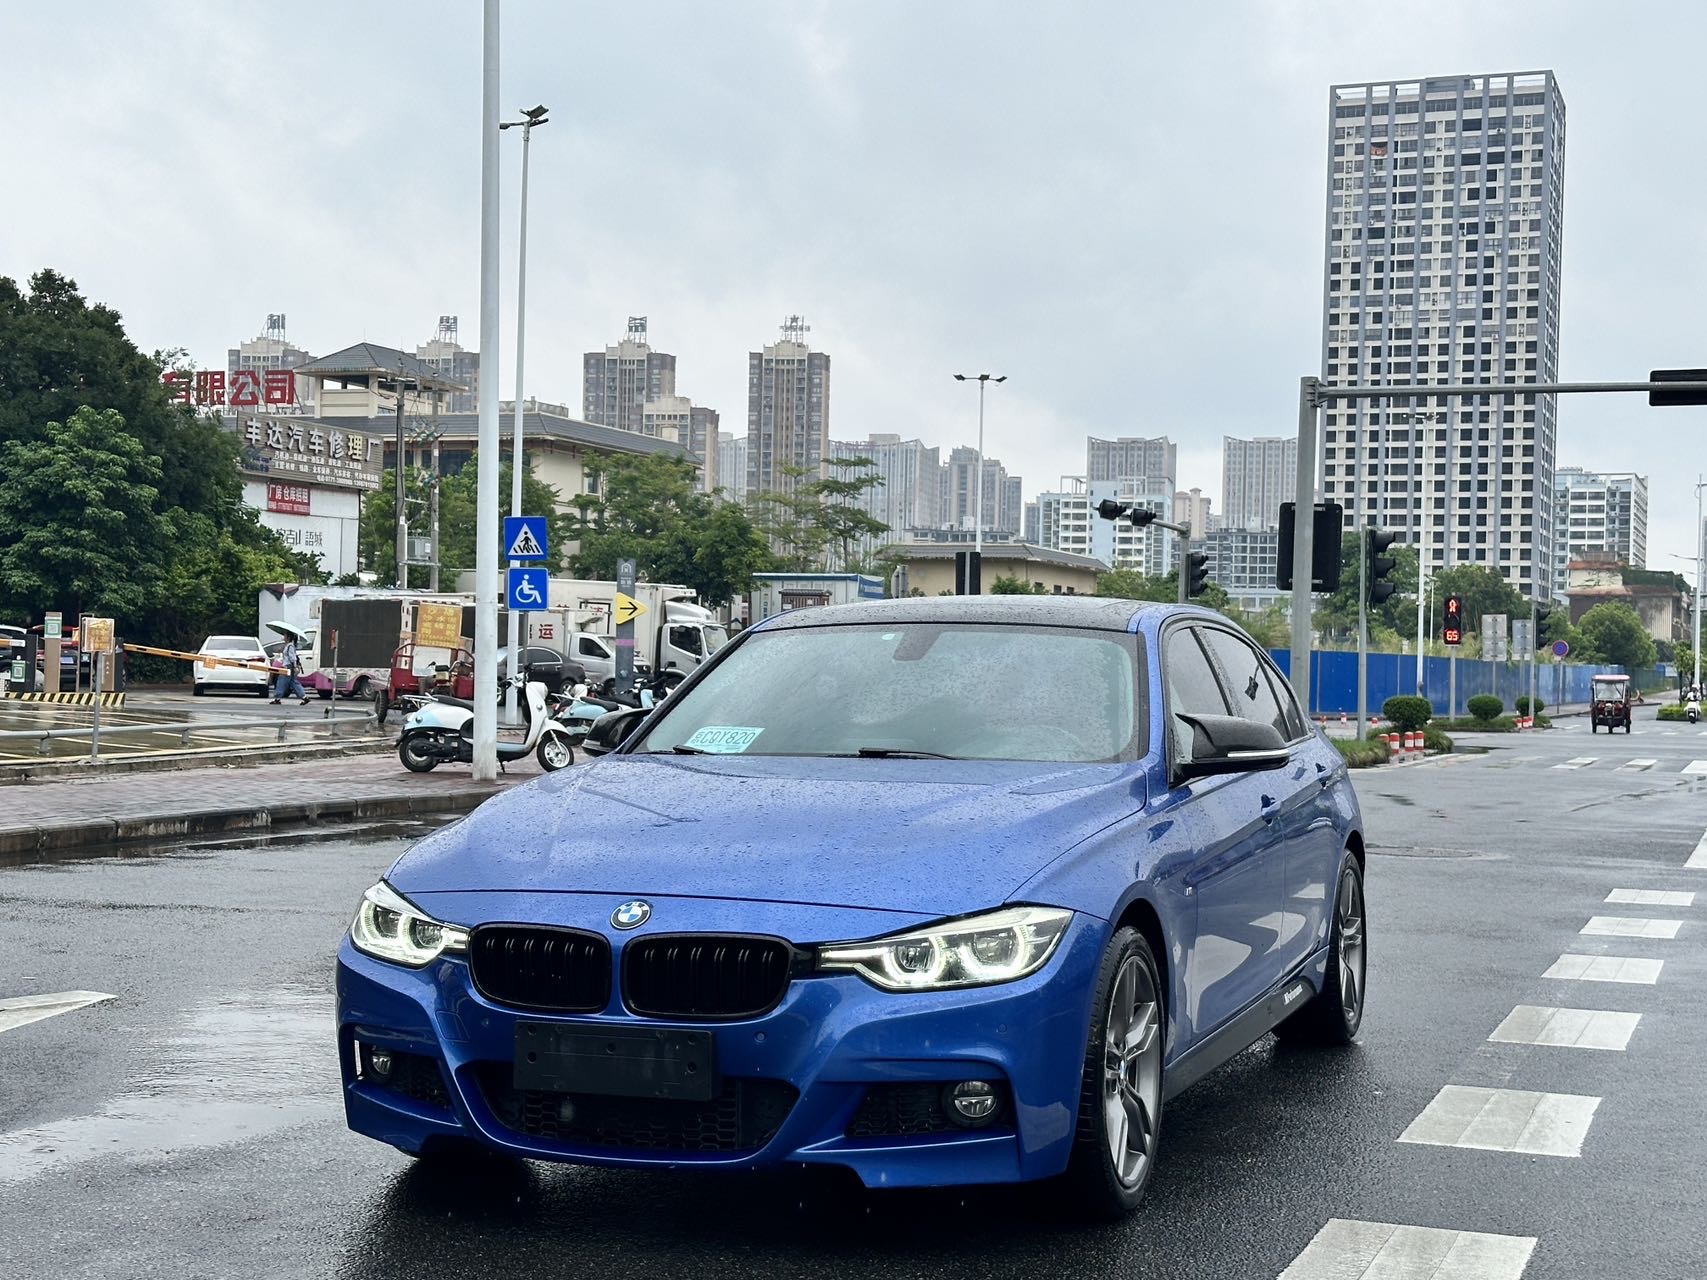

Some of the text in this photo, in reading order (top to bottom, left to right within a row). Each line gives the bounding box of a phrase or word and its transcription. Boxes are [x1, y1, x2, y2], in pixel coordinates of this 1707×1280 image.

[162, 369, 295, 406] 有限公司
[246, 417, 380, 461] 丰达汽车修理厂
